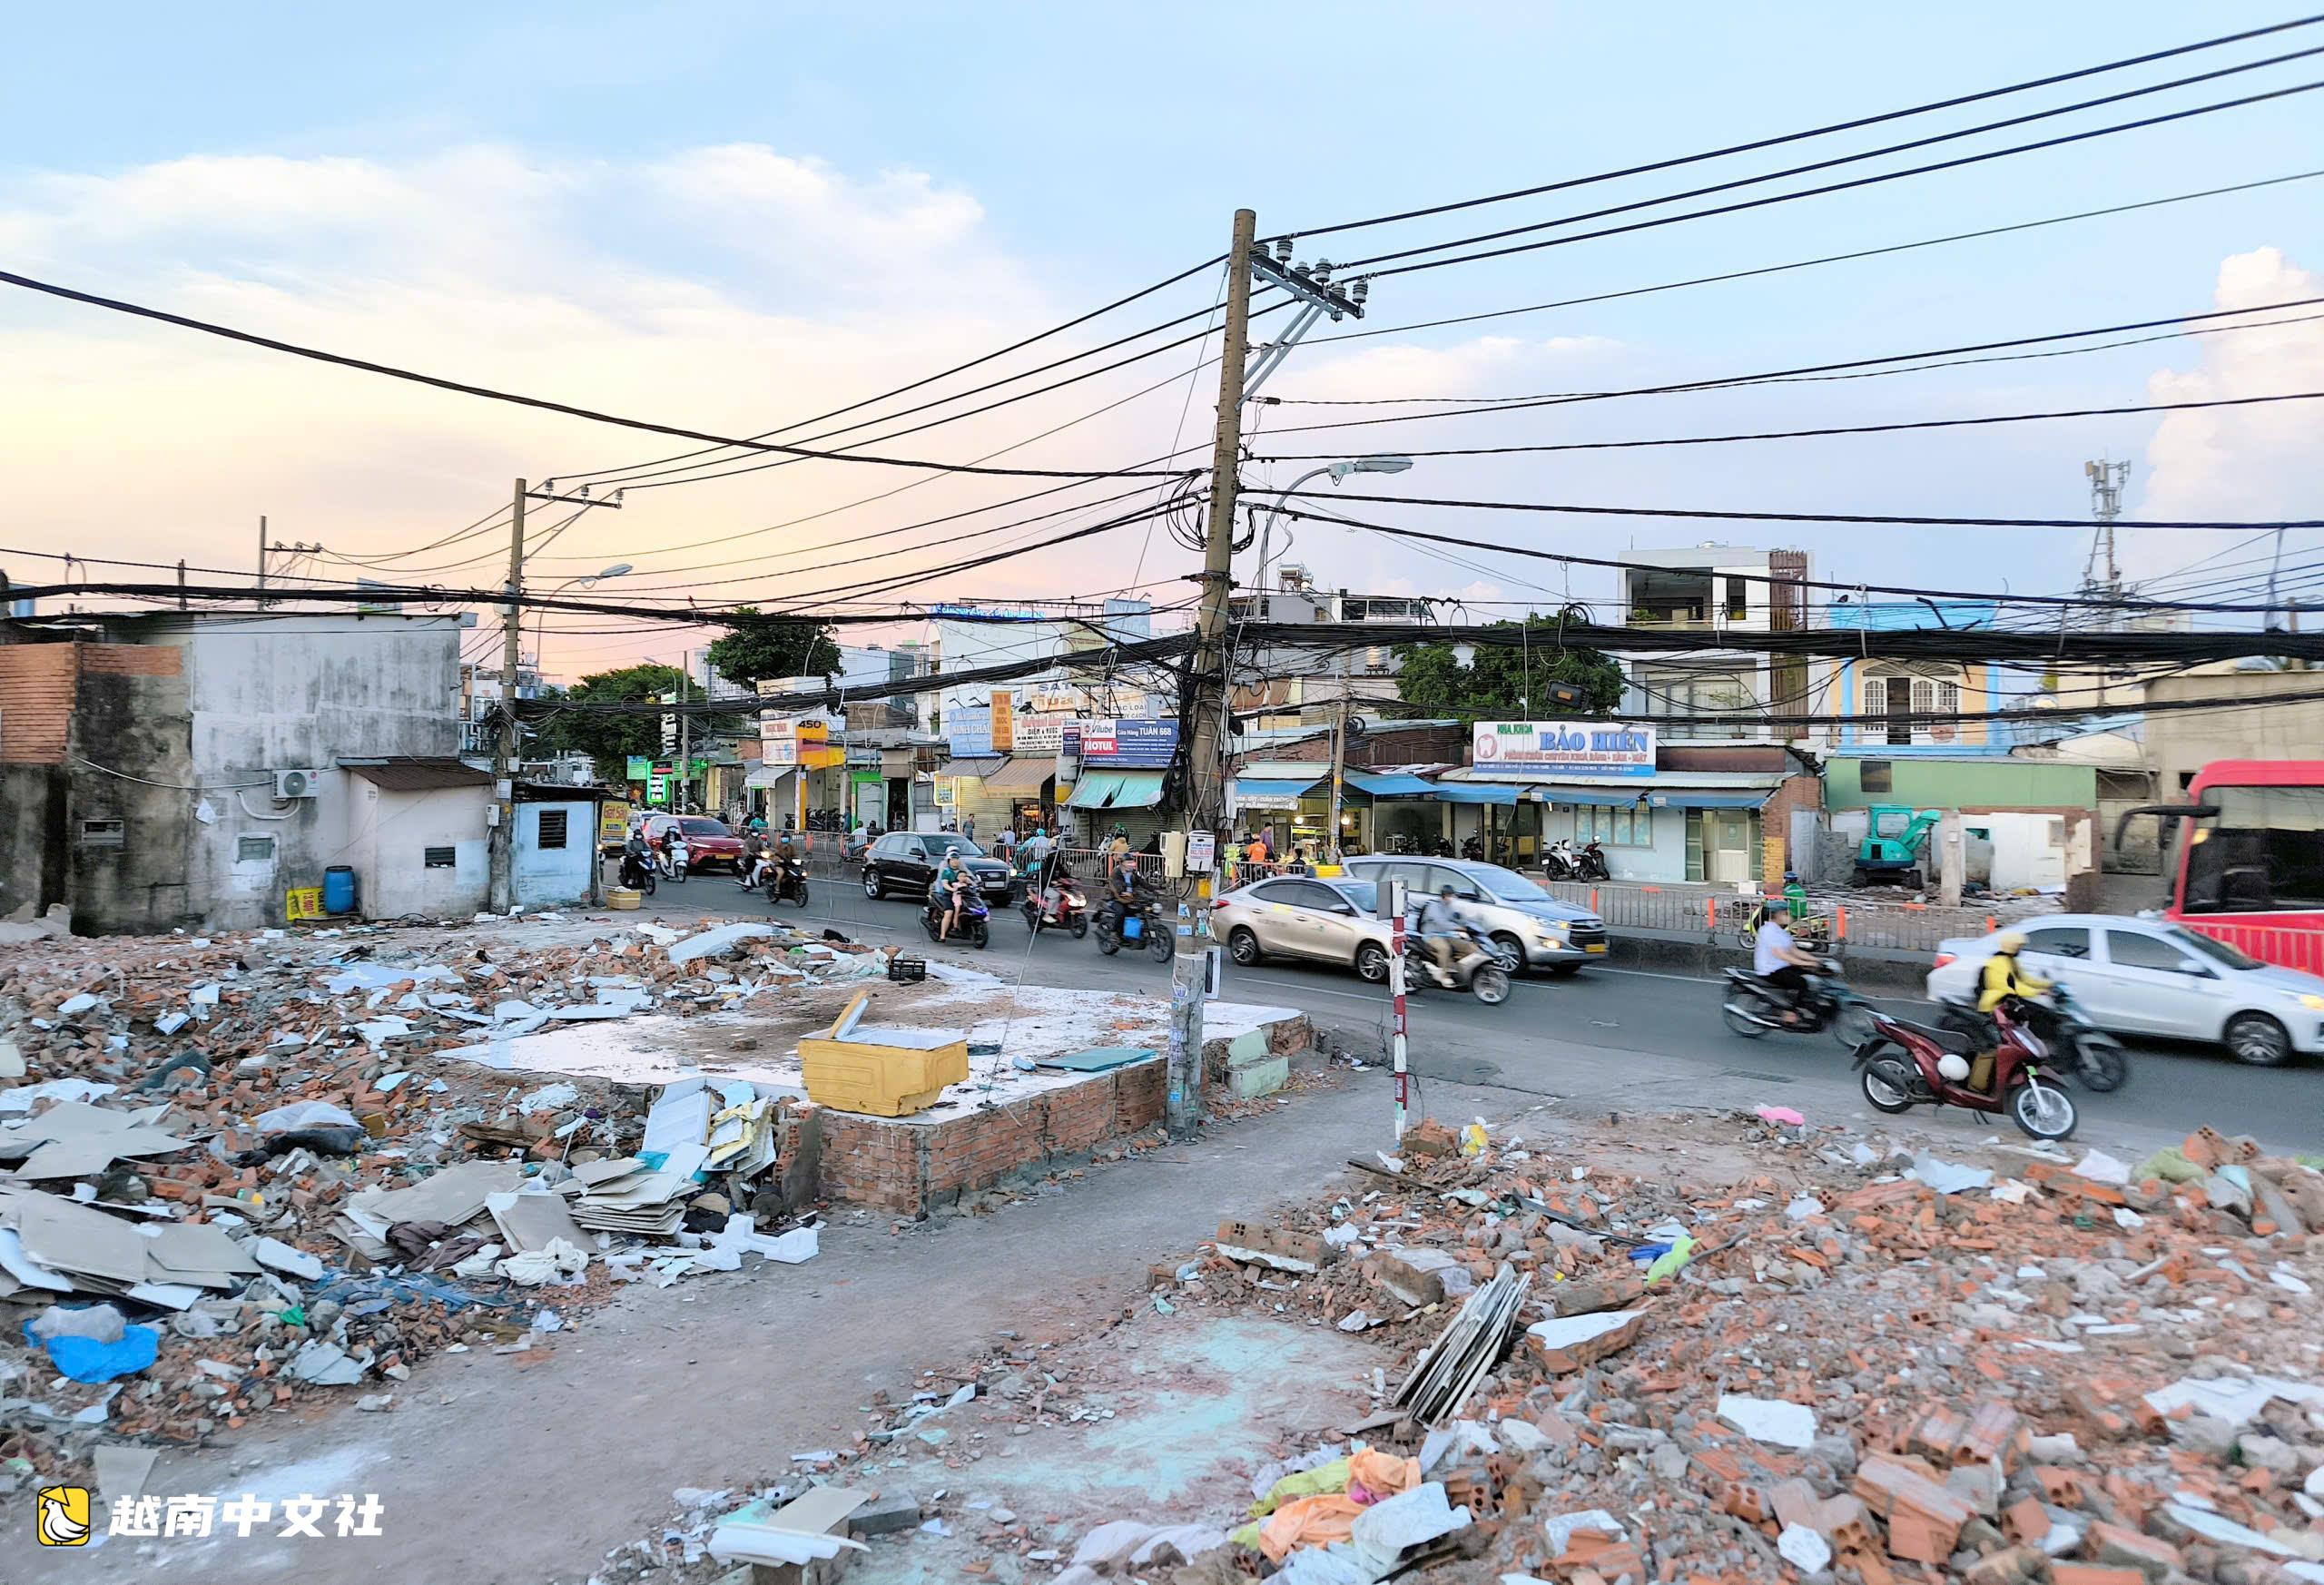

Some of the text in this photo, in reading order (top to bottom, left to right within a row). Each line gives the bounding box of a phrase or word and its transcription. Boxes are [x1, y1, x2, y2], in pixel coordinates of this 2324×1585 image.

[799, 720, 822, 728] 450
[1159, 727, 1172, 735] 668
[1540, 724, 1585, 751] BẢO
[1083, 741, 1114, 751] MOTUL
